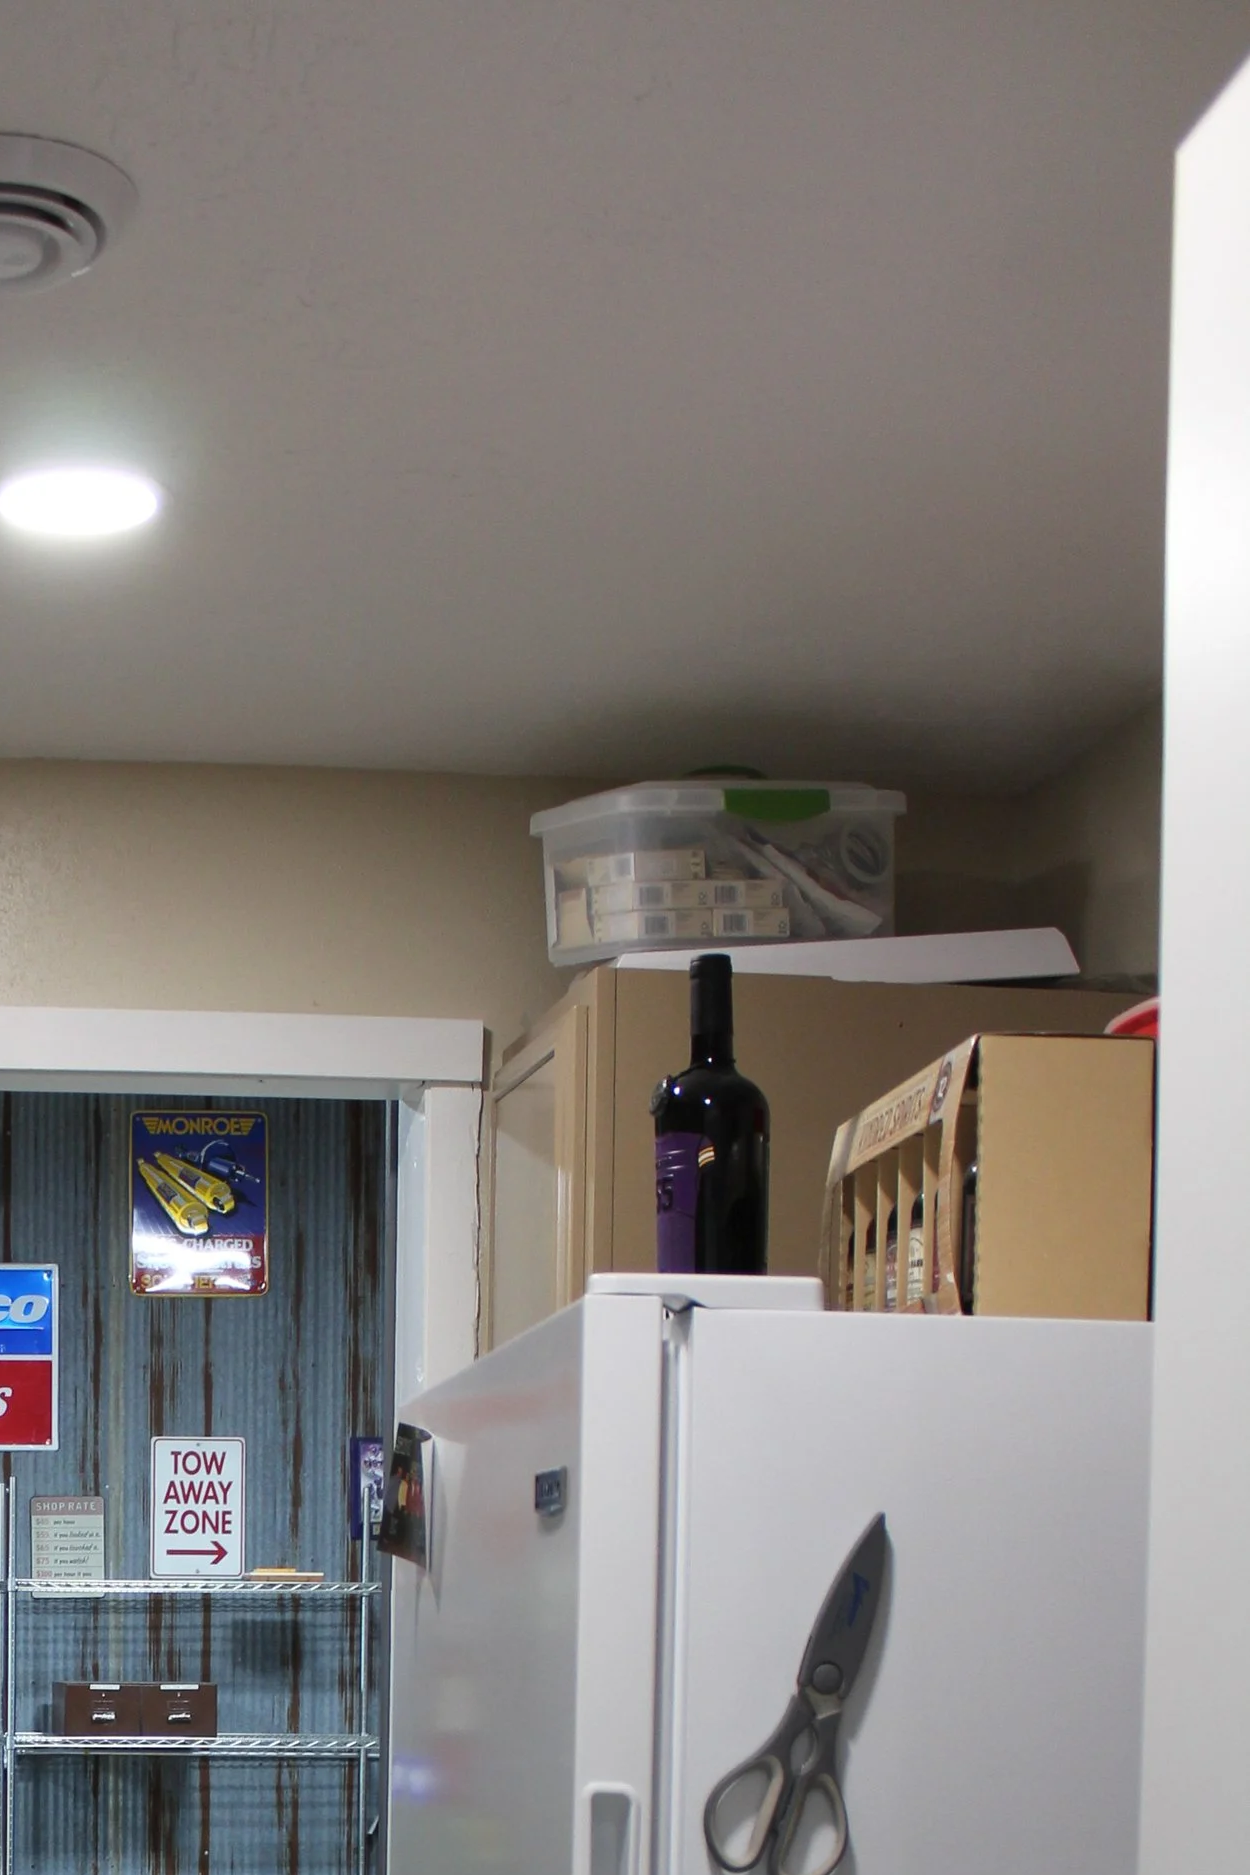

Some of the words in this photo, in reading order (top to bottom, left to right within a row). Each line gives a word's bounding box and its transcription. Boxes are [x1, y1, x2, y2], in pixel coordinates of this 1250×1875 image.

[155, 1116, 242, 1136] MONROE
[170, 1451, 226, 1476] TOW
[163, 1481, 233, 1505] AWAY
[36, 1502, 66, 1512] SHOP
[68, 1501, 97, 1511] RATE
[164, 1510, 232, 1535] ZONE
